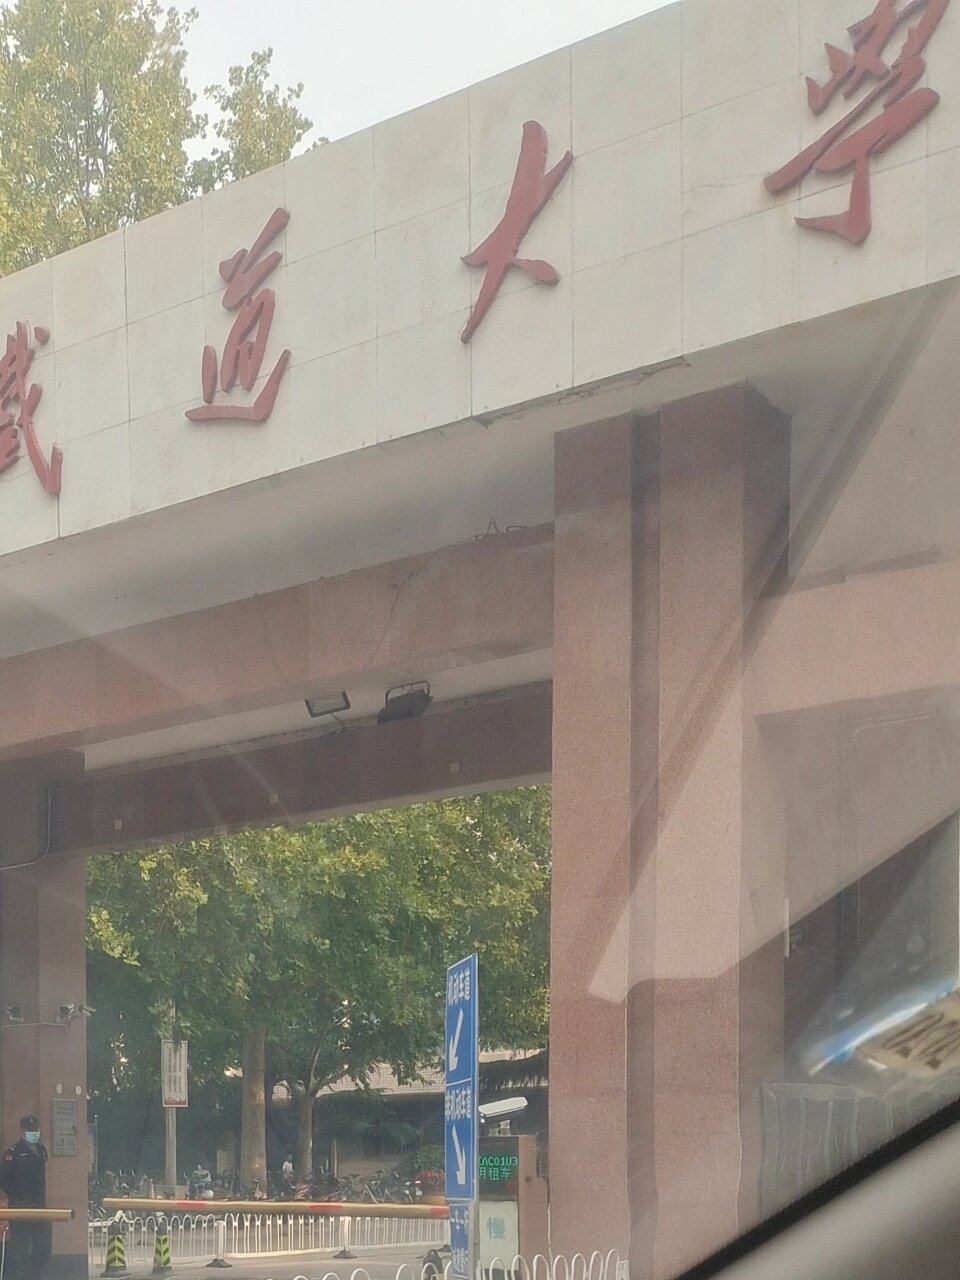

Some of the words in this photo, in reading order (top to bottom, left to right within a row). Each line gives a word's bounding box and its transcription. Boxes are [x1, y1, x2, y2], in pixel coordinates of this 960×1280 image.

[448, 967, 470, 1006] 机动车道
[445, 1086, 471, 1121] 非机动车道
